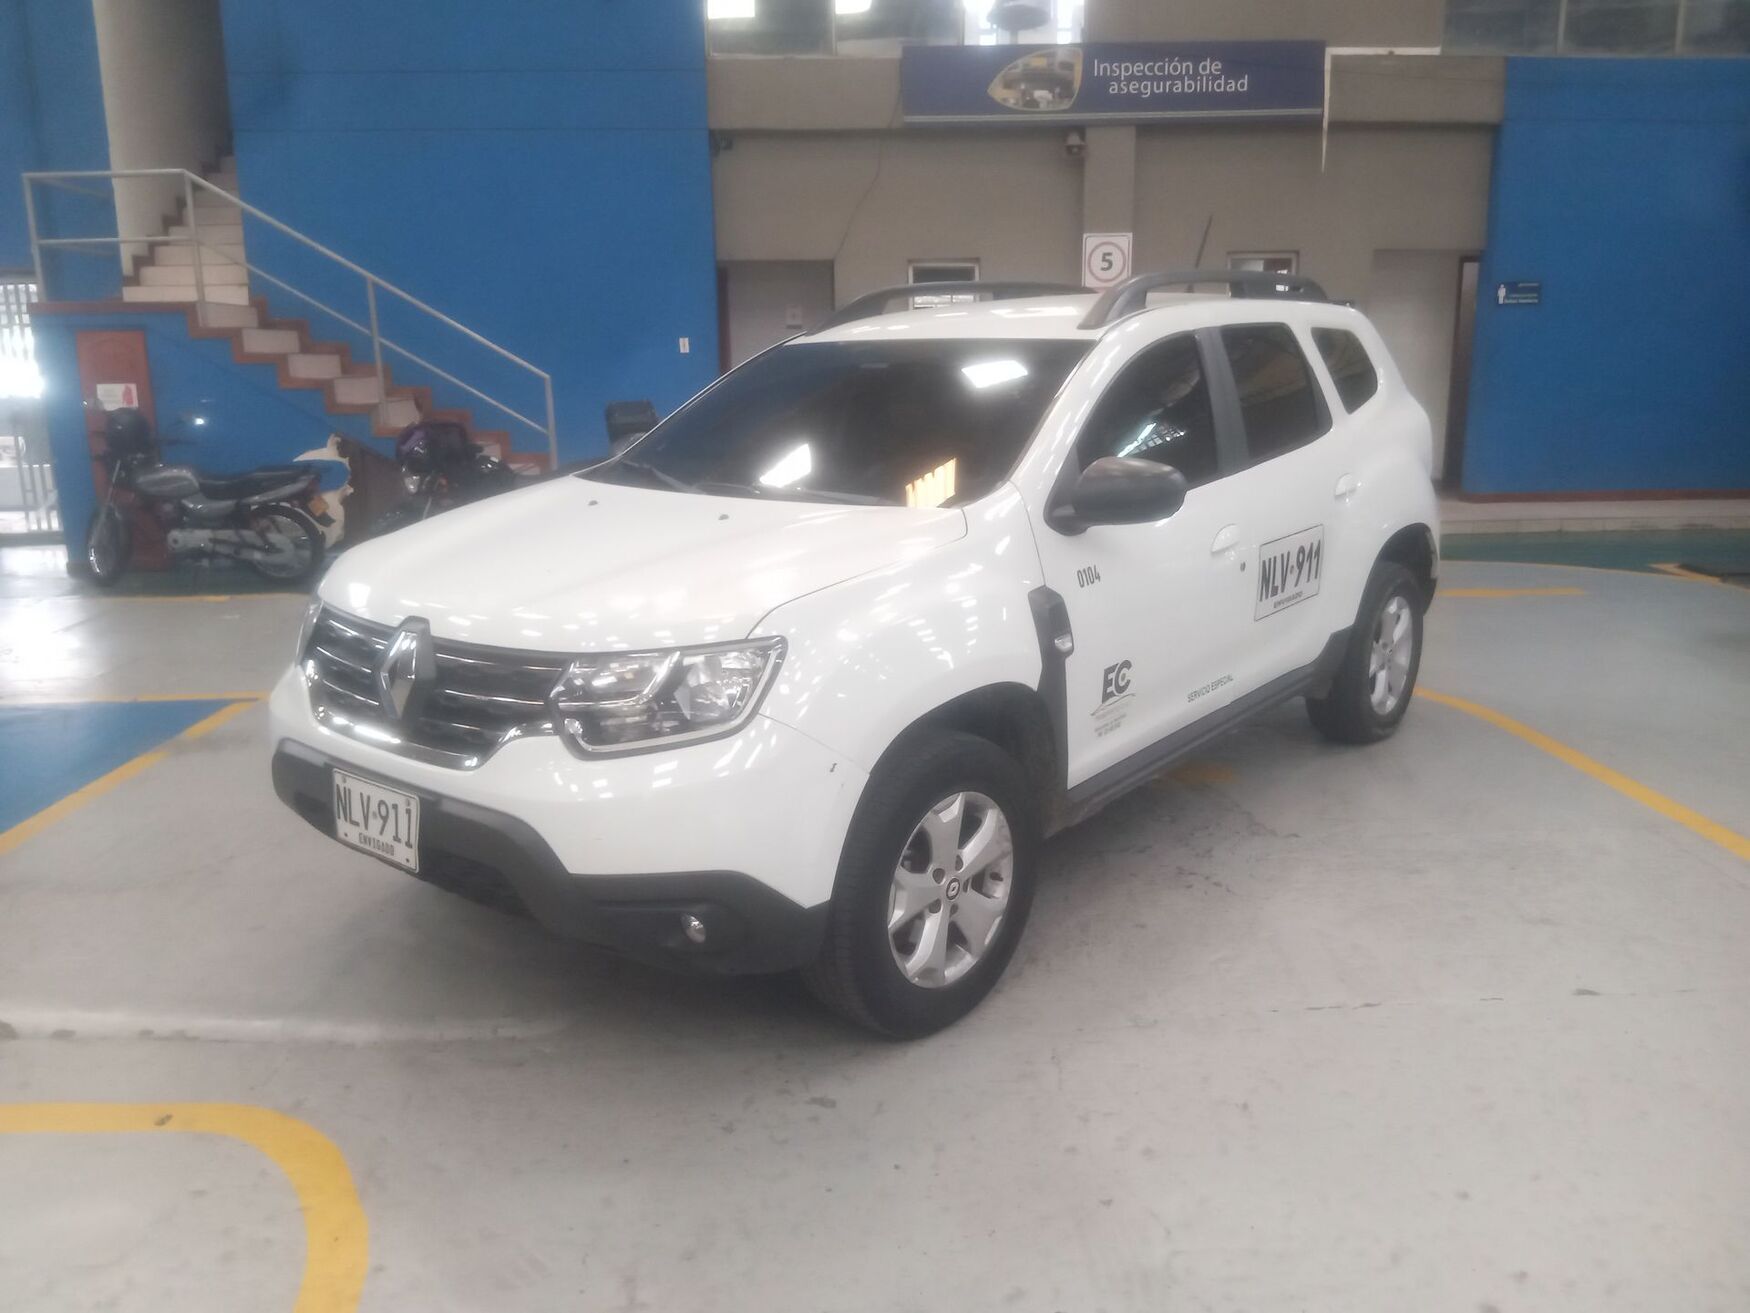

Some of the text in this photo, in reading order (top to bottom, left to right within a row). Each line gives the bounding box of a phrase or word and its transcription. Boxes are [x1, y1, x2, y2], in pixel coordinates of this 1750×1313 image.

[1094, 56, 1222, 81] Inspección de
[1108, 74, 1248, 98] asegurabilidad
[1100, 252, 1114, 272] 5
[1076, 564, 1101, 589] 0104
